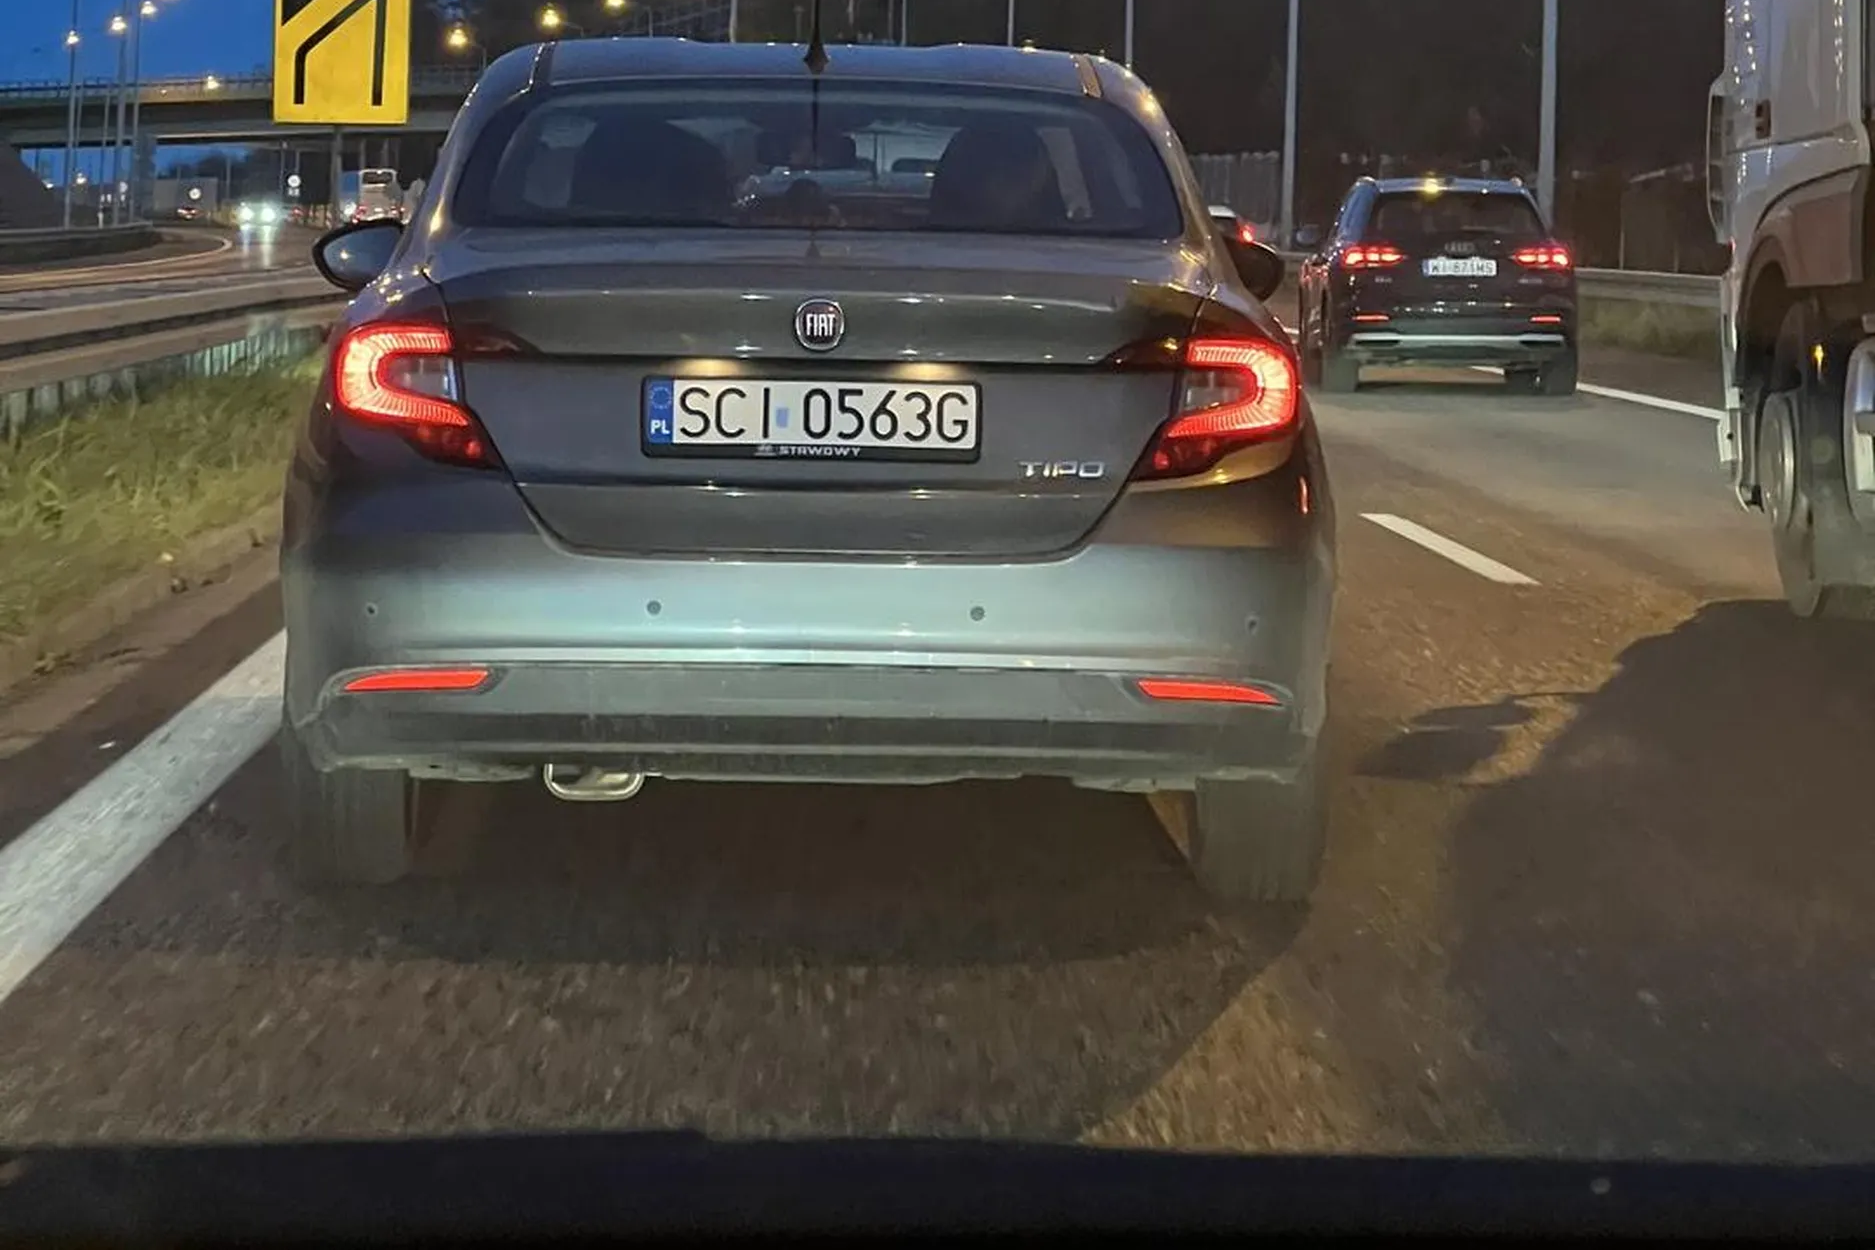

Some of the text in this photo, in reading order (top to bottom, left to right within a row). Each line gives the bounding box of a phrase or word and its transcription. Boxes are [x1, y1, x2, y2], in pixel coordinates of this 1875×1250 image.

[806, 313, 836, 337] FIAT
[679, 386, 969, 443] SCI 0563G
[651, 419, 671, 435] PL
[1019, 460, 1105, 478] TIPO
